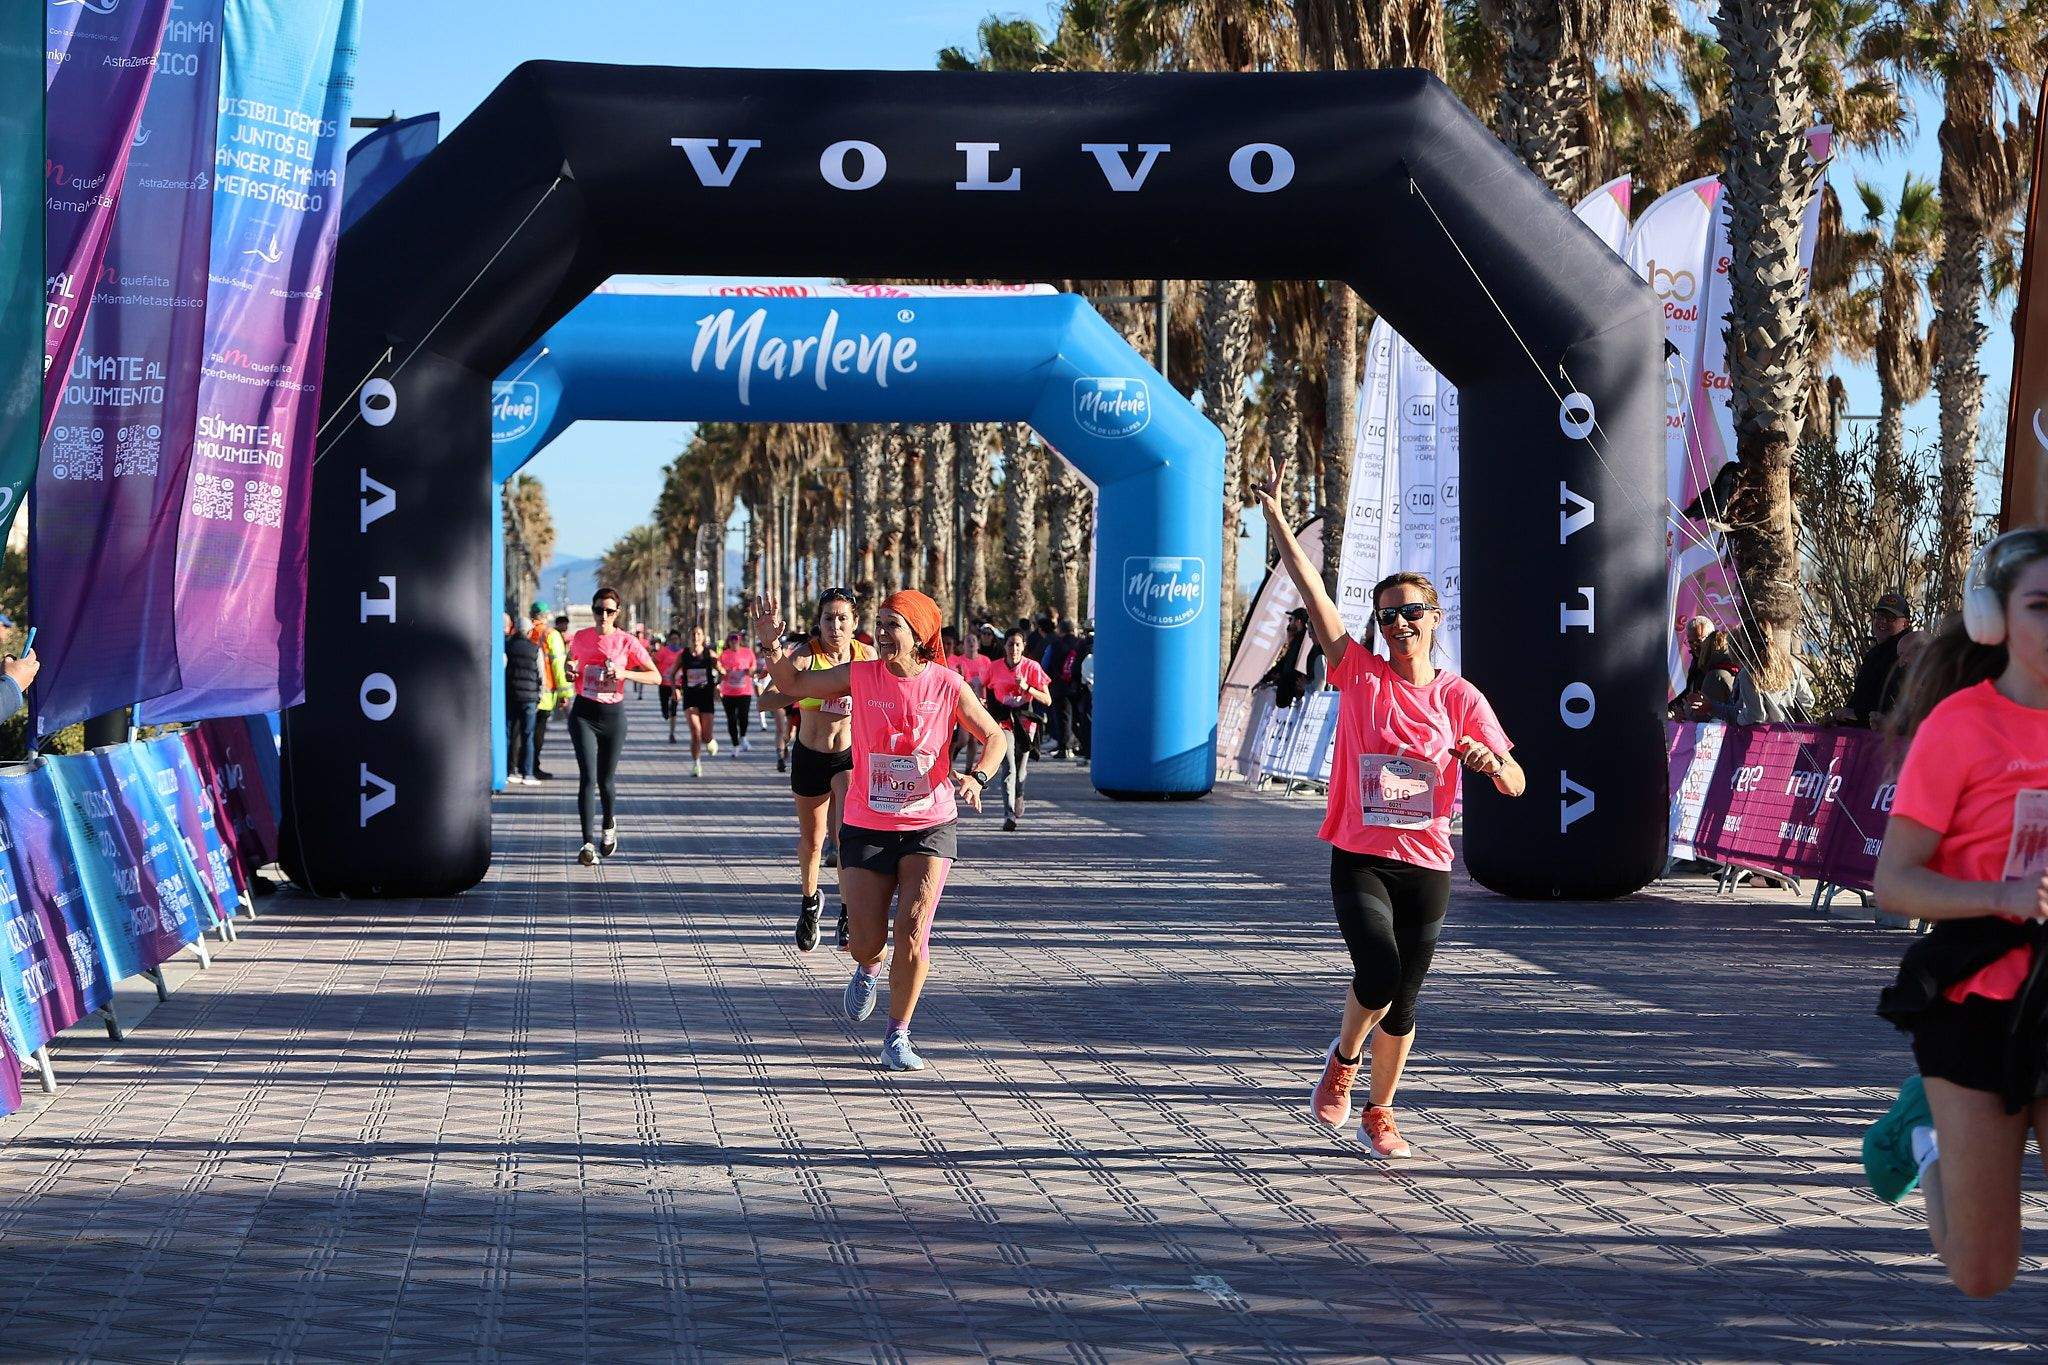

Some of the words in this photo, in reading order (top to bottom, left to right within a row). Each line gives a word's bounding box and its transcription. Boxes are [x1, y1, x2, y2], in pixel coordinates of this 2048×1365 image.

[230, 124, 296, 154] JUNTOS
[296, 140, 312, 161] EL
[215, 144, 270, 175] ÁNCER
[273, 158, 294, 180] DE
[293, 165, 337, 187] MAMA
[671, 137, 1296, 193] VOLVO
[138, 178, 196, 190] AstraZeneca
[214, 174, 322, 212] METASTÁSICO
[91, 293, 204, 309] eMamaMetastásico
[71, 348, 144, 381] ÚMATE
[145, 361, 166, 380] AL
[690, 308, 917, 406] Marlene
[493, 395, 532, 421] rlene
[1080, 390, 1145, 422] Marlene
[199, 413, 270, 445] SÚMATE
[271, 431, 285, 449] AL
[196, 439, 284, 469] MOVIMIENTO
[359, 377, 398, 828] VOLVO
[1128, 572, 1200, 608] Marlene
[1560, 391, 1596, 834] VOLVO
[868, 699, 895, 709] OYSHO
[891, 780, 915, 791] 016
[1384, 787, 1411, 800] 016
[1785, 757, 1843, 816] renfe
[1778, 821, 1796, 840] TREN
